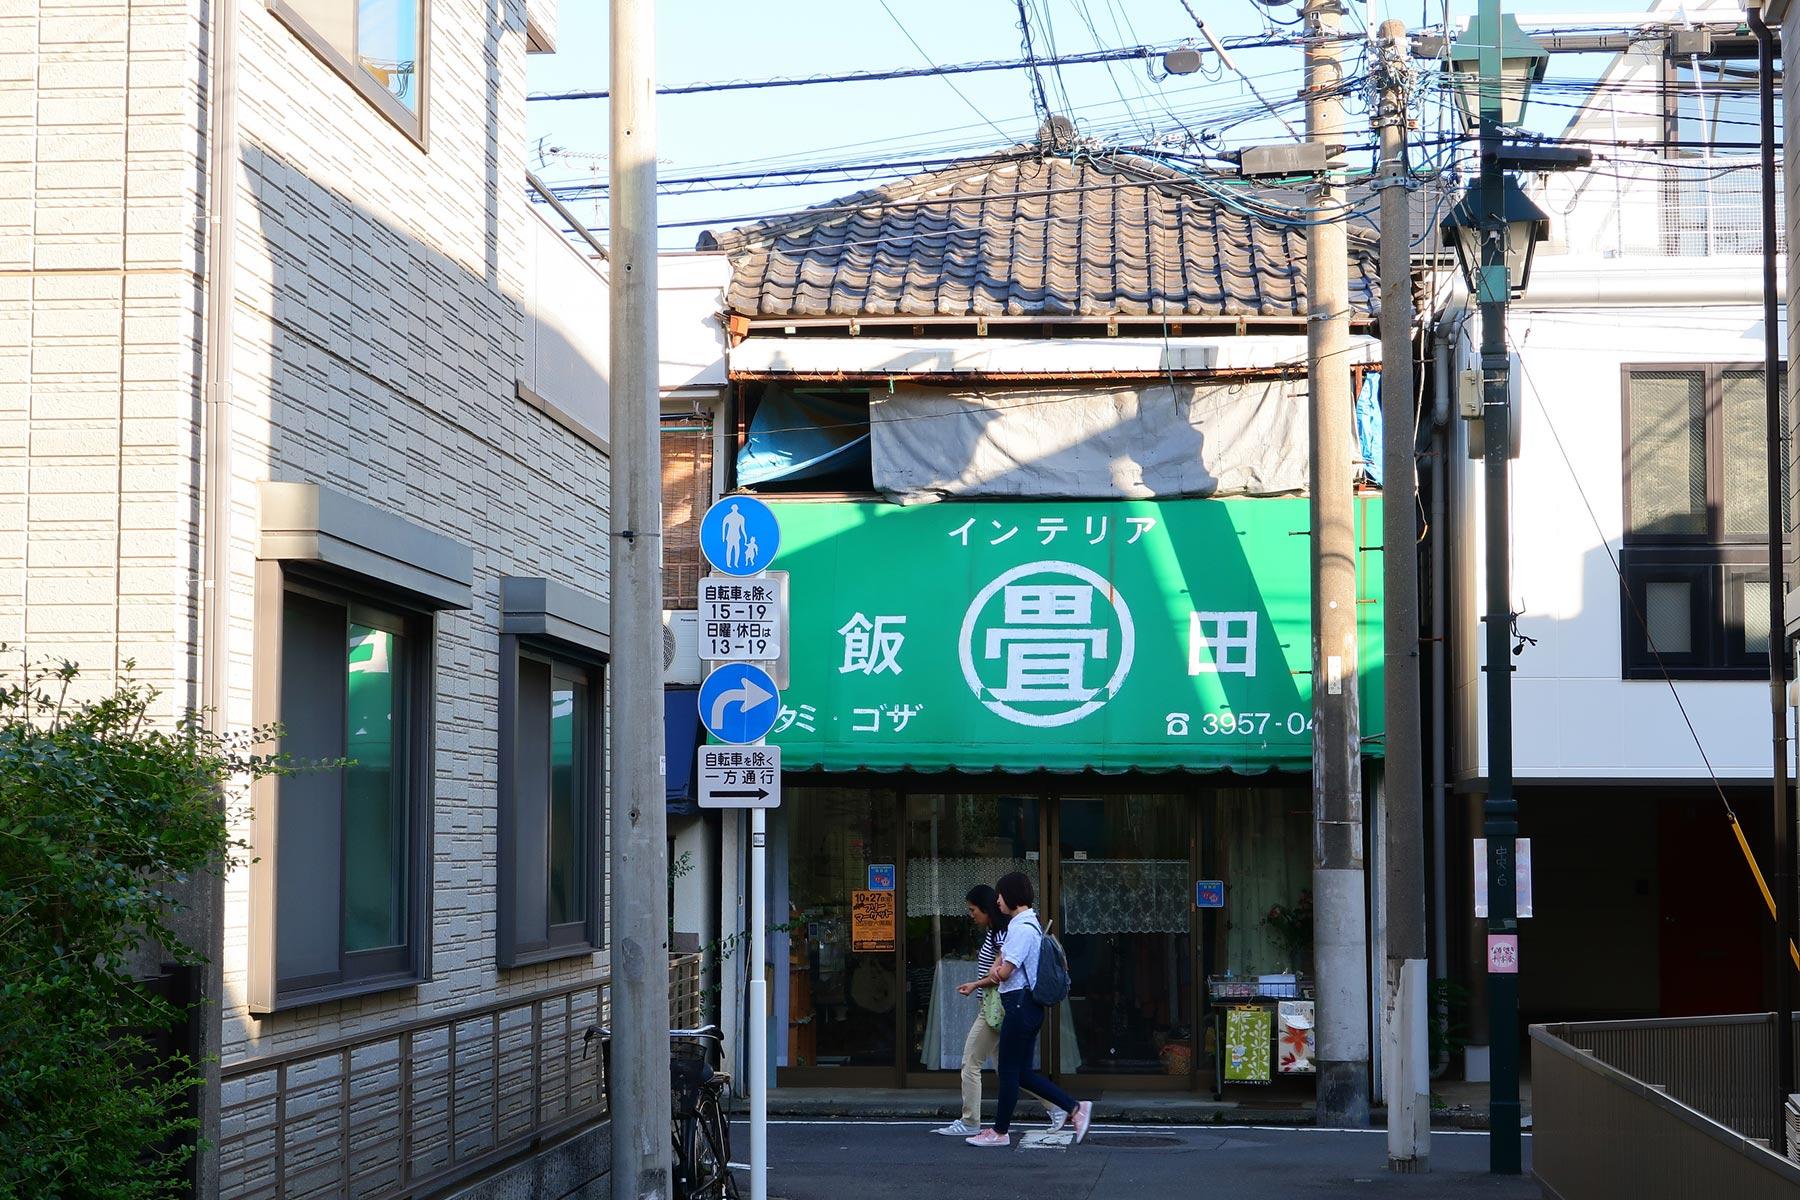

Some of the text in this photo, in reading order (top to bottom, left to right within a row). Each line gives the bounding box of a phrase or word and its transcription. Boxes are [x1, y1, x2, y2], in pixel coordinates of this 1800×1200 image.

[948, 516, 1157, 546] インテリア
[705, 585, 773, 601] 自転車を除く
[712, 604, 767, 619] 15-19
[707, 623, 771, 638] 日曜・休日は
[712, 639, 767, 654] 13-19
[837, 585, 1258, 702] 飯 畳 田
[705, 752, 773, 767] 自転車を除く
[705, 770, 774, 785] 一方通行
